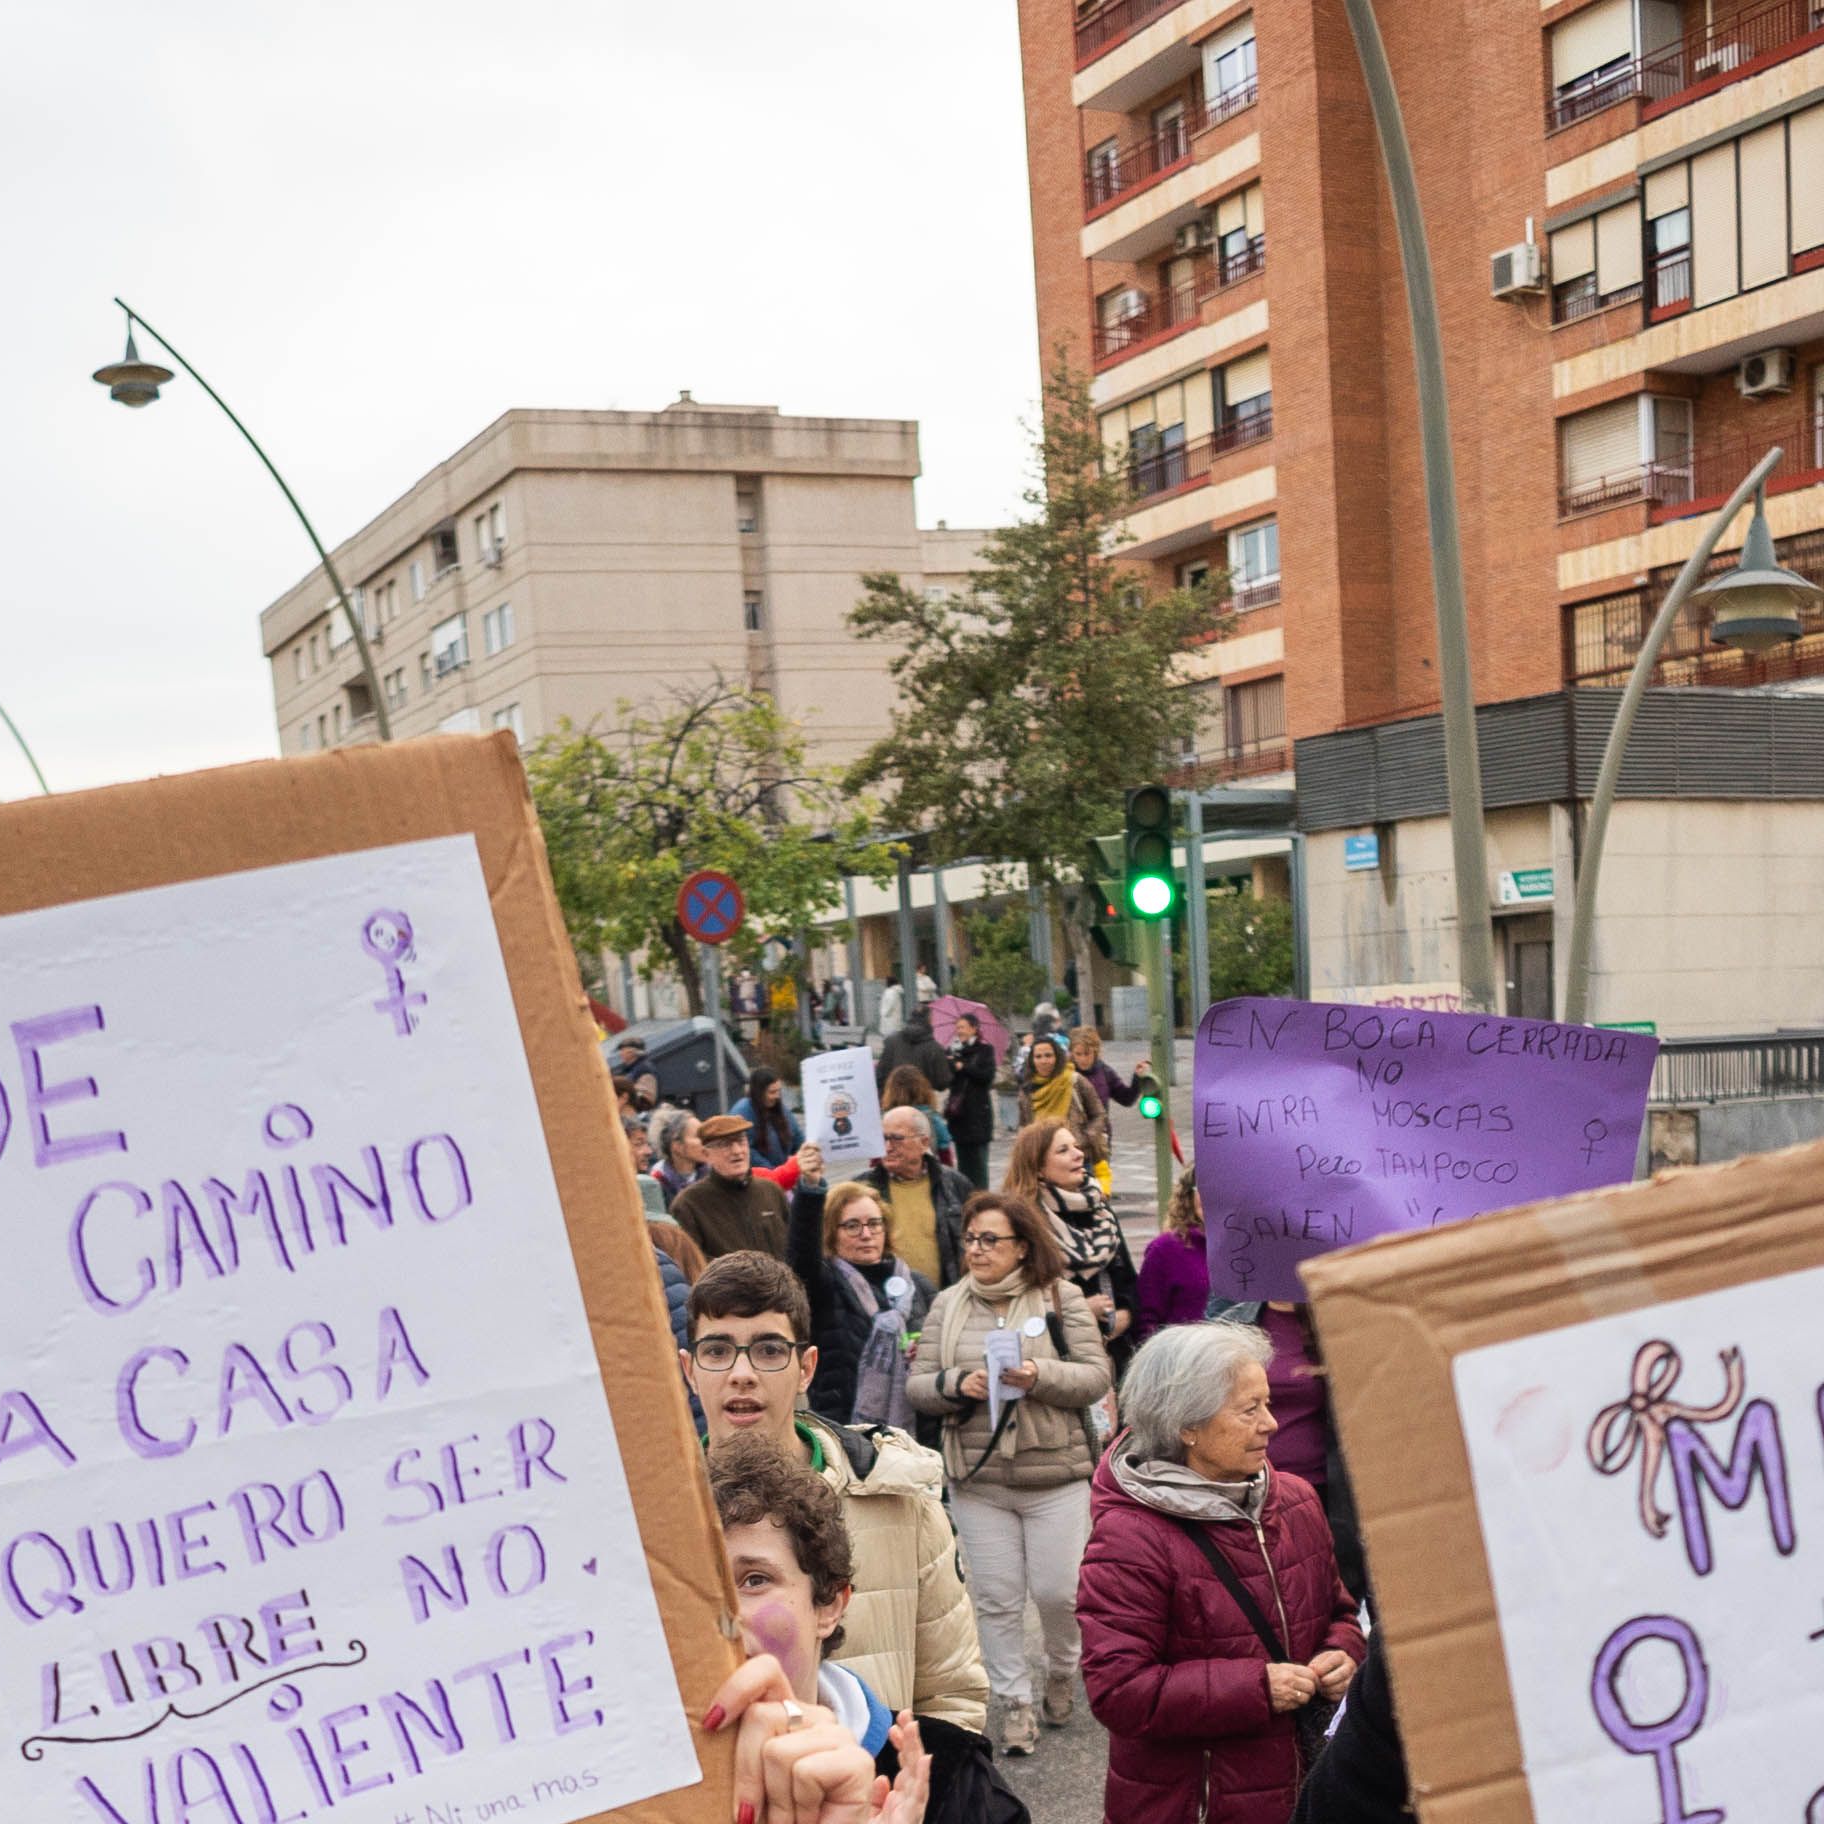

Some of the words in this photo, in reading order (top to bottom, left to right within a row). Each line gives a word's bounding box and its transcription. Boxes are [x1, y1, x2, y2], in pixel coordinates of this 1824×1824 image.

[1209, 1005, 1299, 1050] EN
[1324, 1007, 1436, 1051] BOCA
[1466, 1022, 1630, 1065] CERRADA
[1357, 1056, 1404, 1093] NO
[1203, 1094, 1319, 1138] ENTRA
[1372, 1100, 1514, 1132] MOSCAS
[1376, 1148, 1519, 1185] TAMPOCO
[1223, 1206, 1354, 1253] SALEN
[115, 1307, 432, 1459] CASA
[0, 1468, 347, 1625] QUIERO
[383, 1415, 570, 1529] SER
[39, 1588, 326, 1732] LIBRE
[400, 1522, 547, 1624] NO
[475, 1793, 527, 1822] una
[532, 1768, 601, 1802] mas
